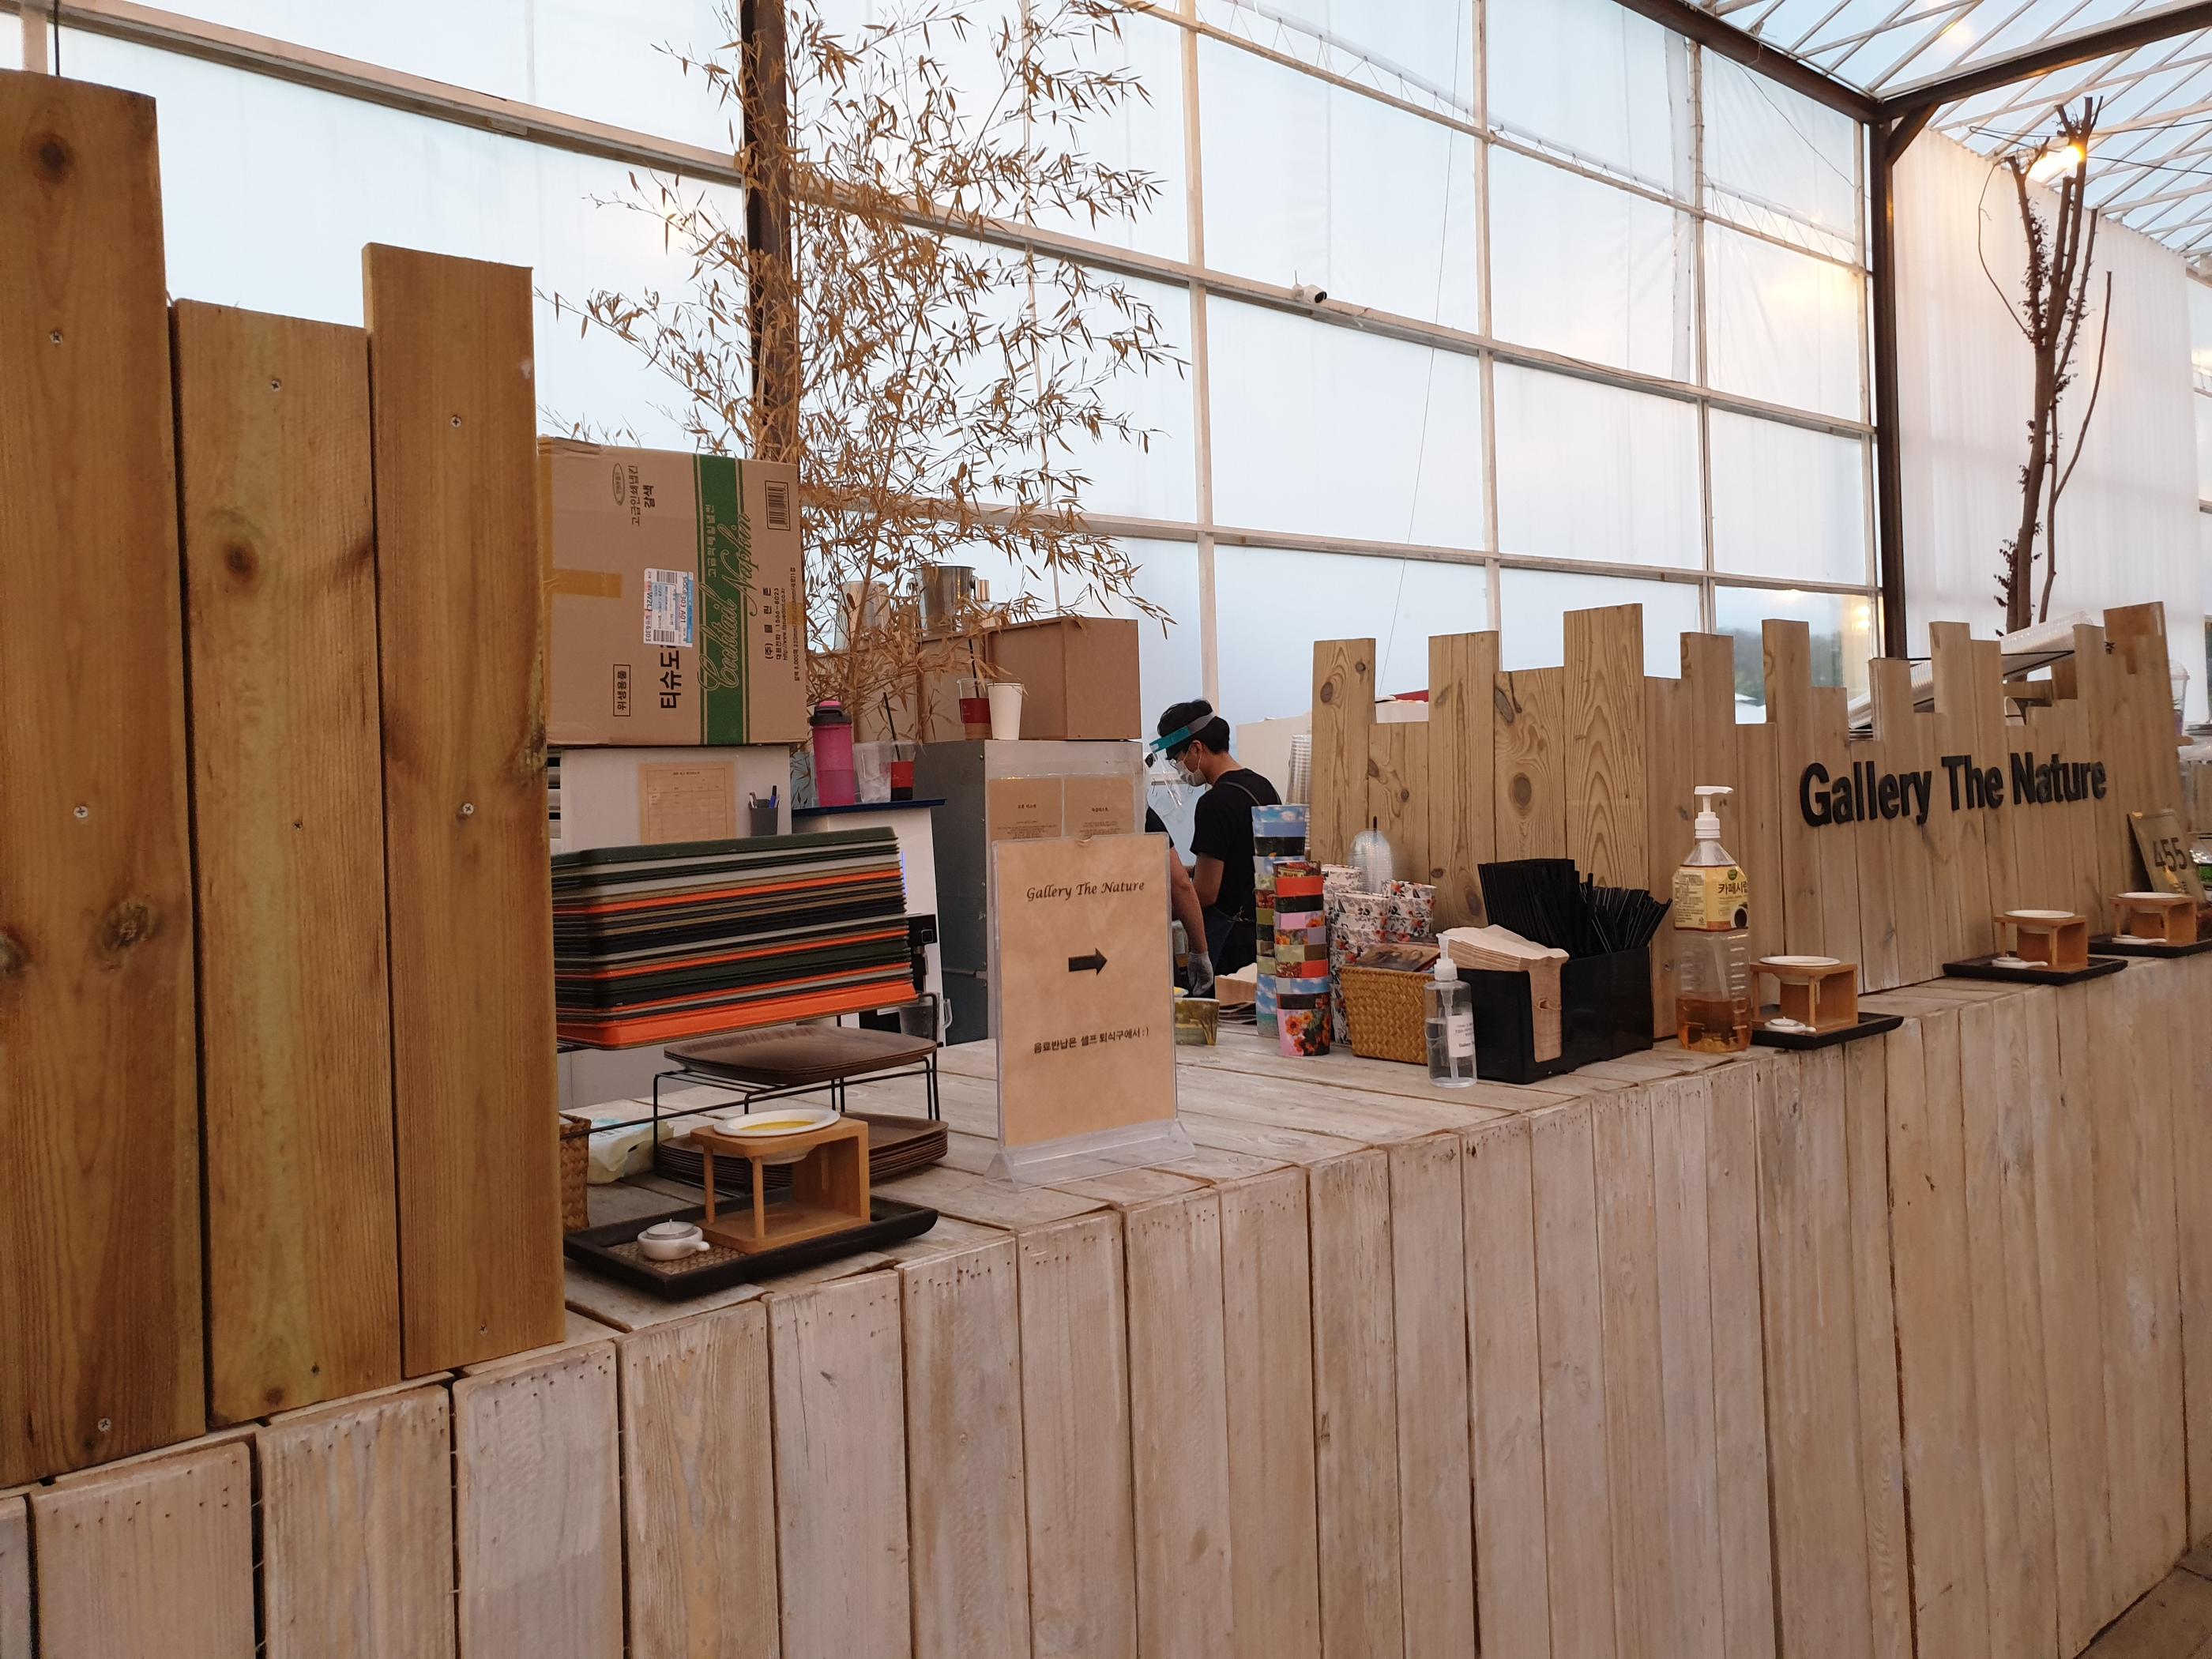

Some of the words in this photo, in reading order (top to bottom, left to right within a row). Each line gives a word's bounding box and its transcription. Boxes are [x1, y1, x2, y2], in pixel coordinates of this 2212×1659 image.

[642, 484, 655, 510] 갈색
[717, 513, 759, 617] Napkin
[697, 582, 739, 690] Cocktail
[617, 670, 627, 710] 위생용품
[660, 644, 683, 709] 티슈도
[1800, 762, 1932, 826] Gallery
[1941, 754, 2004, 811] The
[2010, 751, 2107, 804] Nature
[2153, 837, 2188, 872] 455
[1026, 885, 1072, 901] Gallery
[1076, 882, 1097, 896] The
[1102, 879, 1145, 893] Nature
[1033, 1036, 1078, 1054] 음료반납은
[1081, 1033, 1098, 1047] 셀프
